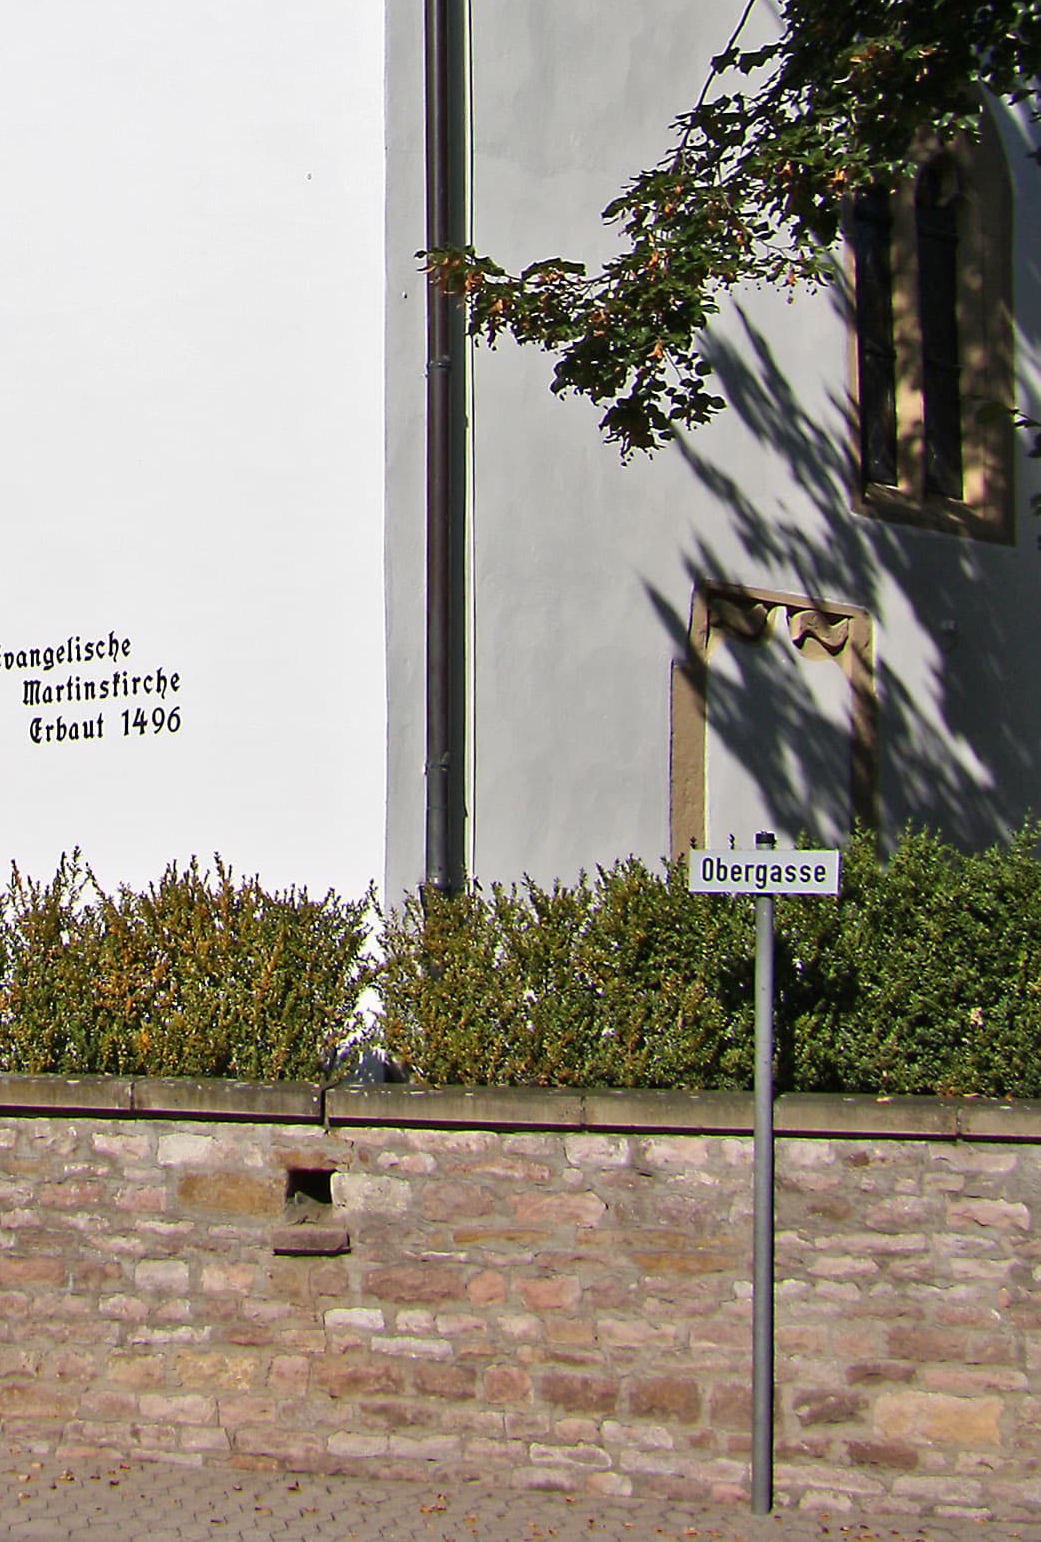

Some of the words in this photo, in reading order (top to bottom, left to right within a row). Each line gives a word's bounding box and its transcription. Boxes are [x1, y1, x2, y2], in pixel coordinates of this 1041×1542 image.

[22, 667, 181, 706] Martinskirche
[29, 712, 104, 744] Erbaut
[121, 705, 182, 736] 1496
[702, 857, 826, 889] Obergasse
